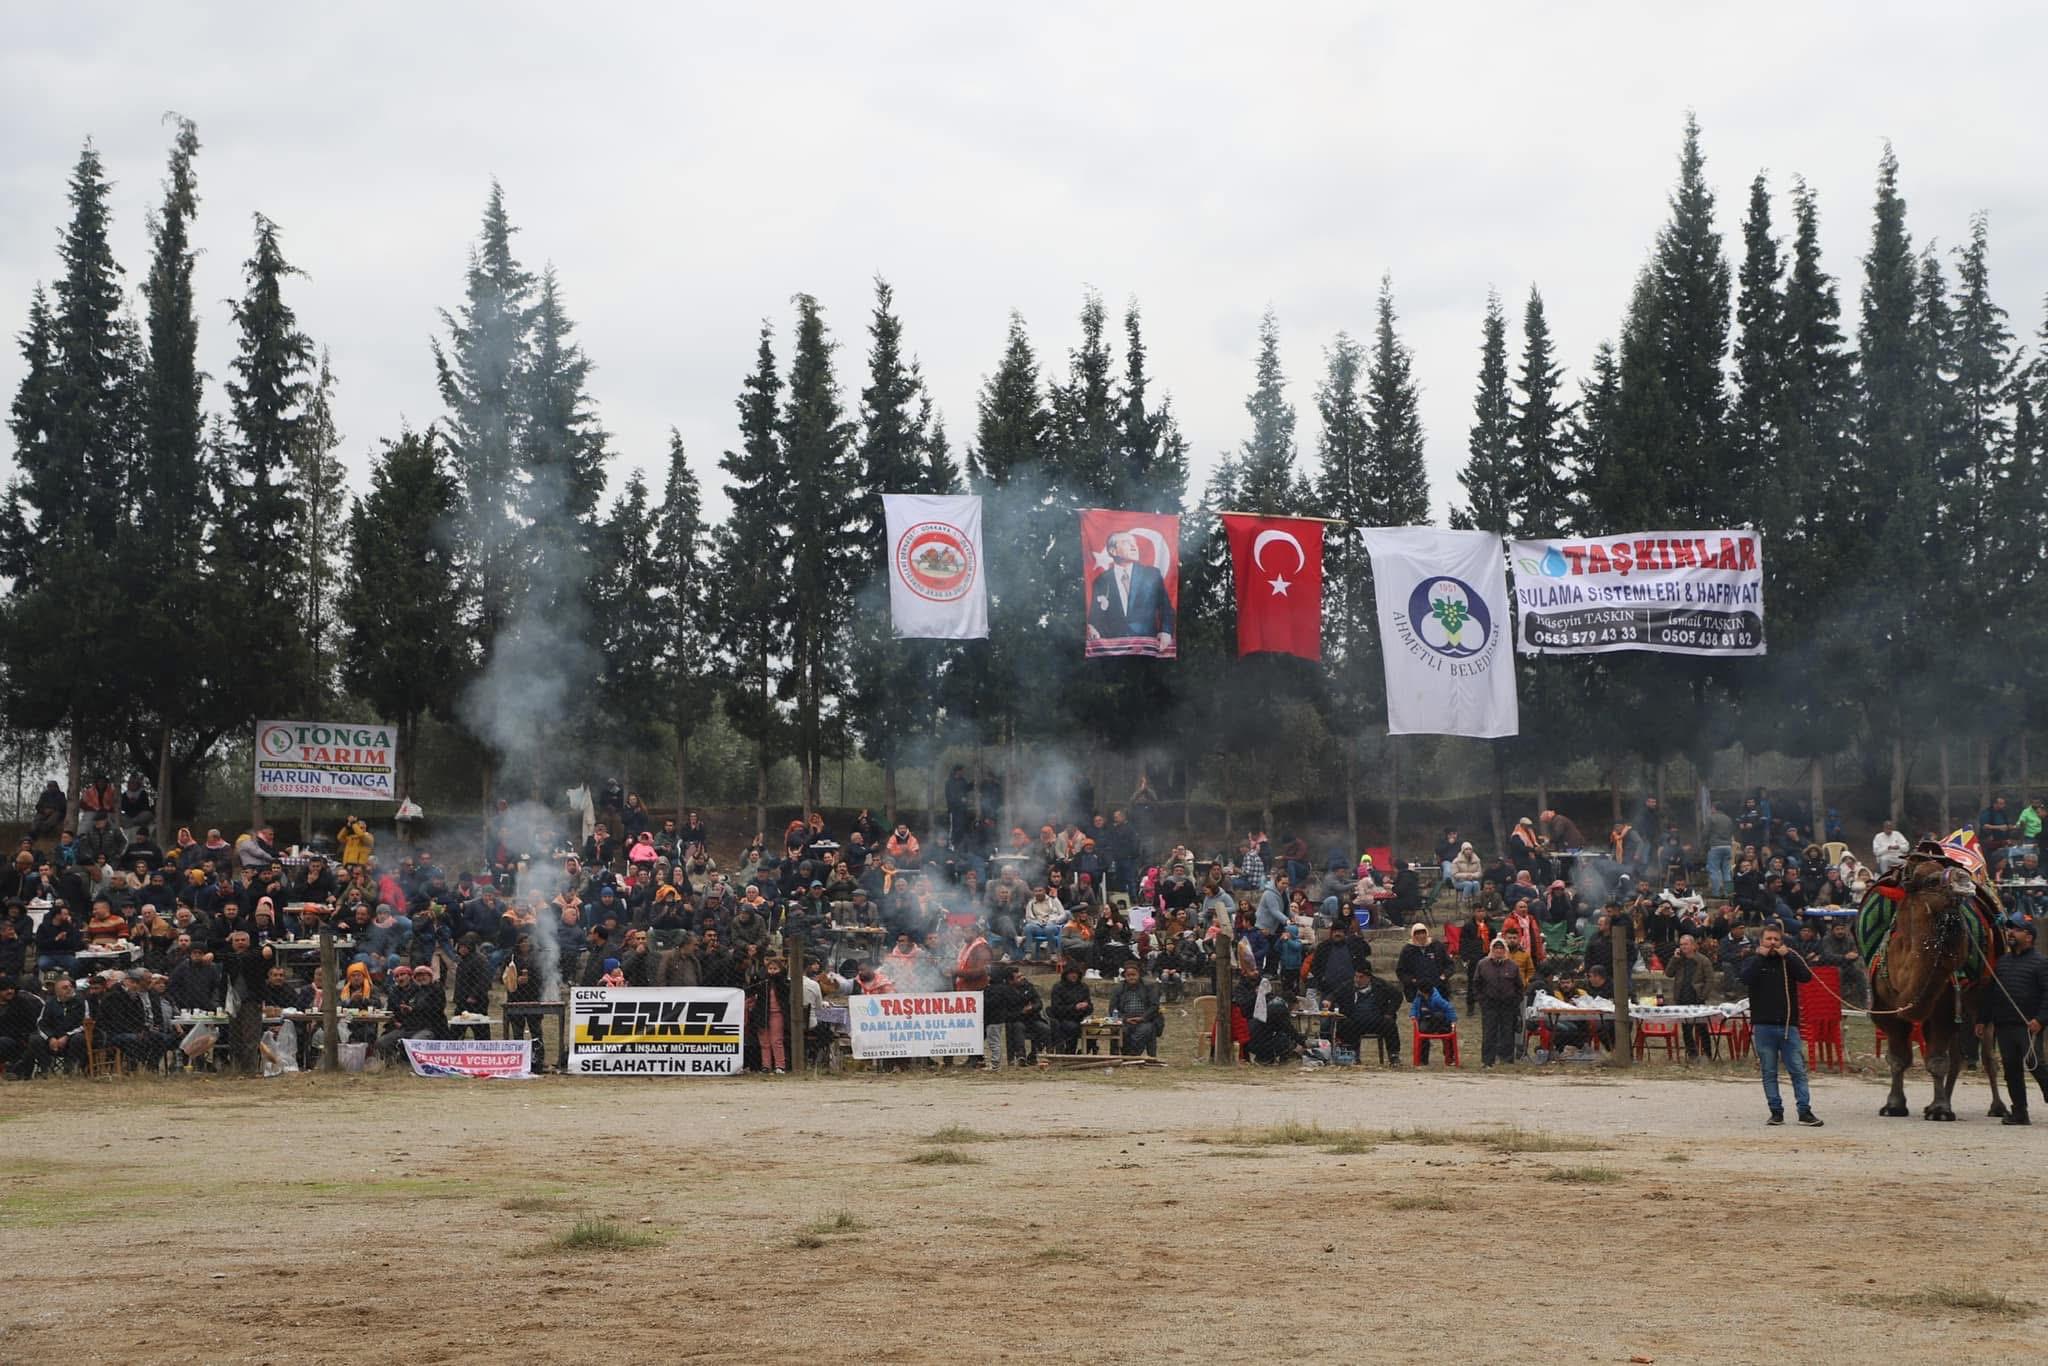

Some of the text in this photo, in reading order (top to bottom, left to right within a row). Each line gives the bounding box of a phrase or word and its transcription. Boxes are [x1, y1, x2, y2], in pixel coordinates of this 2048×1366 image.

[1563, 537, 1757, 577] TAŞKINLAR
[1519, 584, 1583, 608] SULAMA
[1685, 582, 1693, 602] &
[1584, 610, 1635, 625] TAŞKIN
[1703, 616, 1745, 631] TAŞKIN
[1535, 626, 1637, 645] 0553 579 43 33
[1662, 629, 1695, 644] 0505
[295, 727, 391, 748] TONGA
[300, 747, 385, 764] TARIM
[262, 770, 388, 787] HARUN TONGA
[576, 990, 606, 1002] GENÇ
[880, 997, 977, 1019] TAŞKINLAR
[860, 1018, 975, 1032] DAMLAMA SULAMA
[635, 1043, 667, 1054] İNŞAAT
[581, 1057, 731, 1072] SELAHATTİN BAKİ
